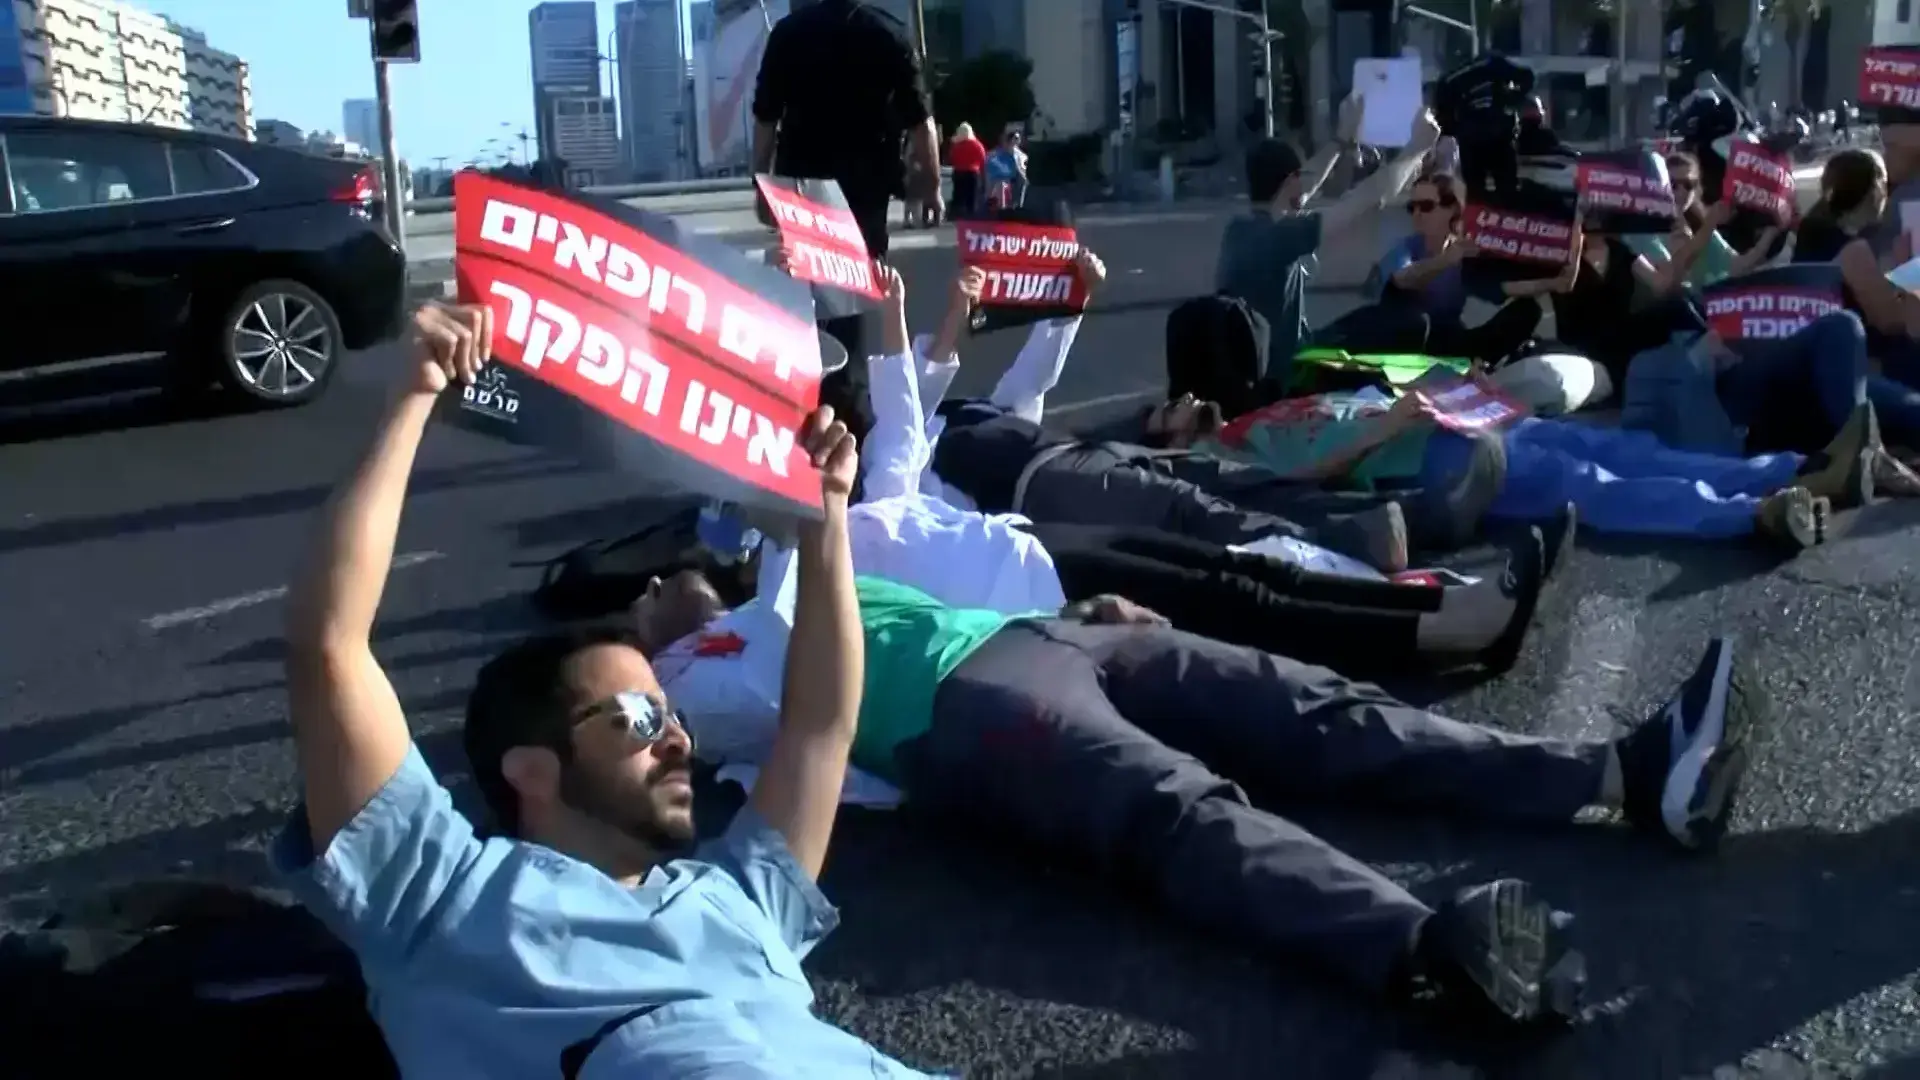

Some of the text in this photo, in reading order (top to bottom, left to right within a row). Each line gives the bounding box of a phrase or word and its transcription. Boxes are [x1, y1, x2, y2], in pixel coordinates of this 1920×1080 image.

[480, 199, 707, 334] רופאים
[965, 229, 1026, 256] ישראל
[985, 269, 1074, 301] תתעורר
[490, 280, 795, 478] אינו הפקר
